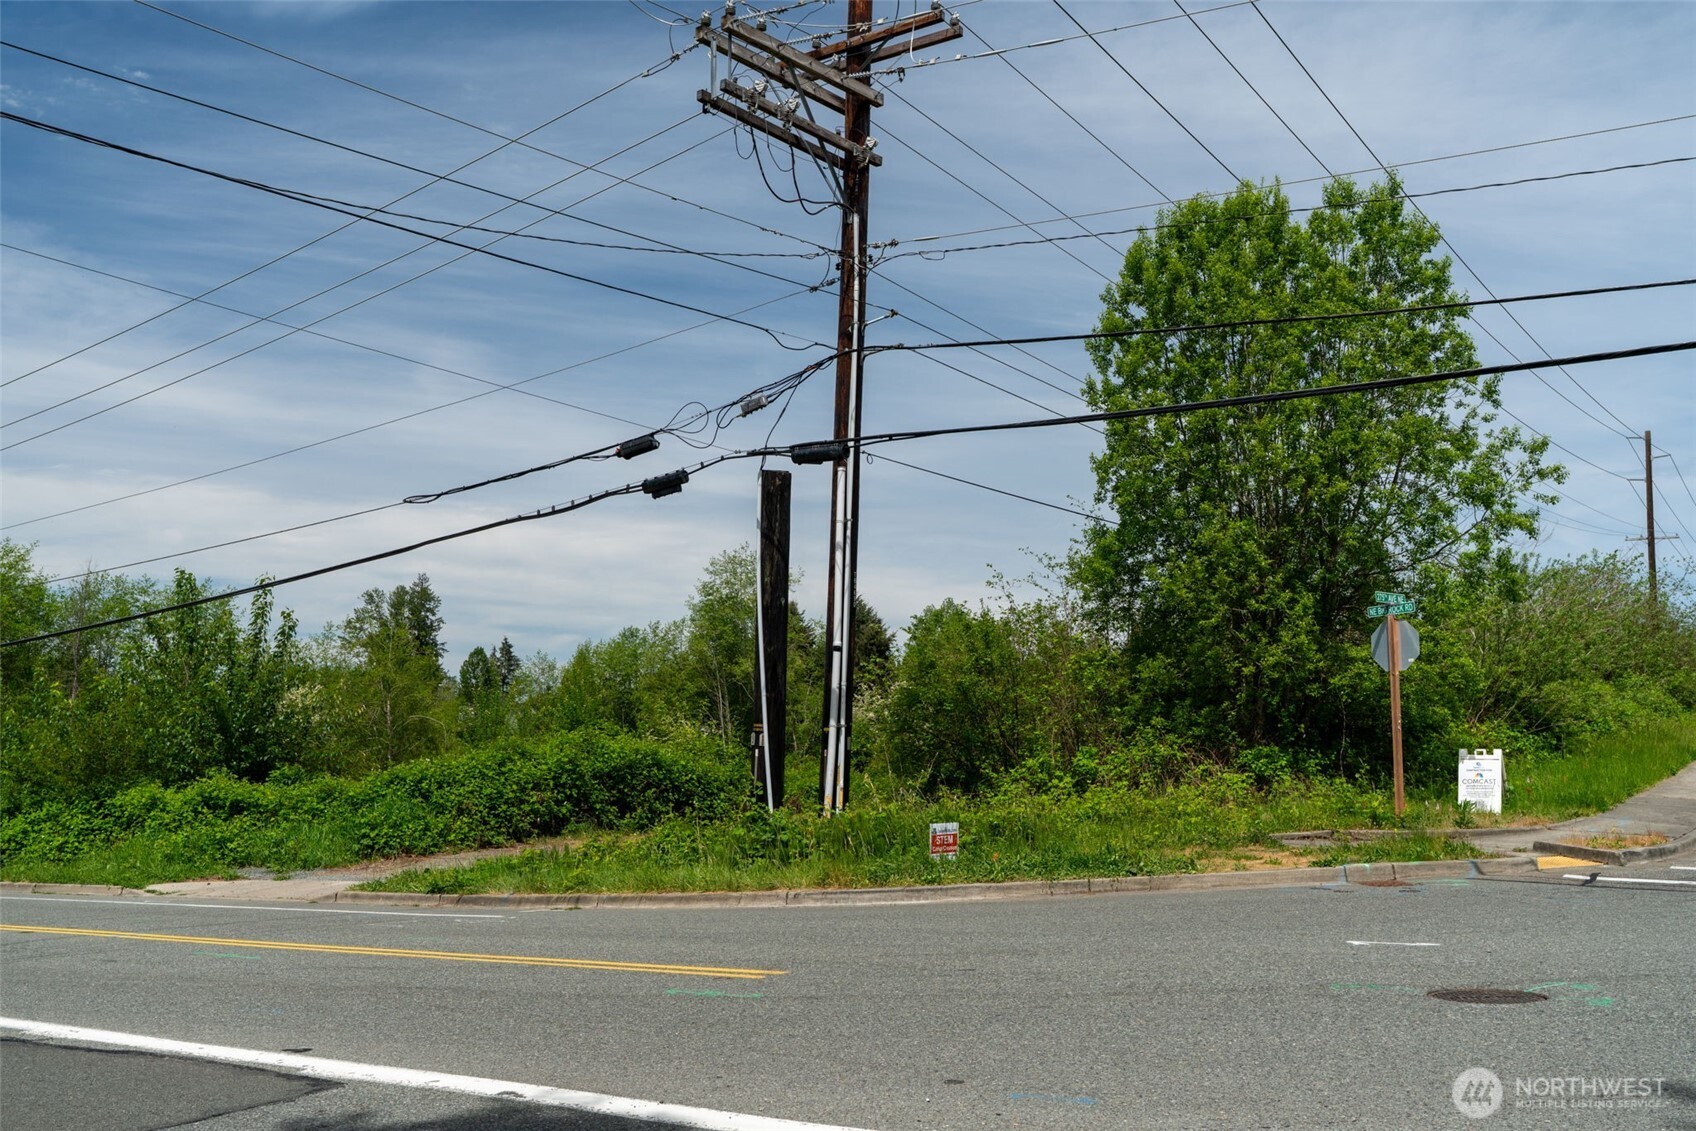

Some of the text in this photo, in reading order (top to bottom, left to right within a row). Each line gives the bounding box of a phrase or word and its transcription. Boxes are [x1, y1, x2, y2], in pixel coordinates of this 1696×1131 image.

[1388, 595, 1397, 603] AVE
[1397, 596, 1404, 604] NE
[1369, 607, 1377, 615] NE
[1388, 604, 1404, 614] ROCK
[1405, 603, 1413, 611] RD
[936, 835, 953, 845] STEM
